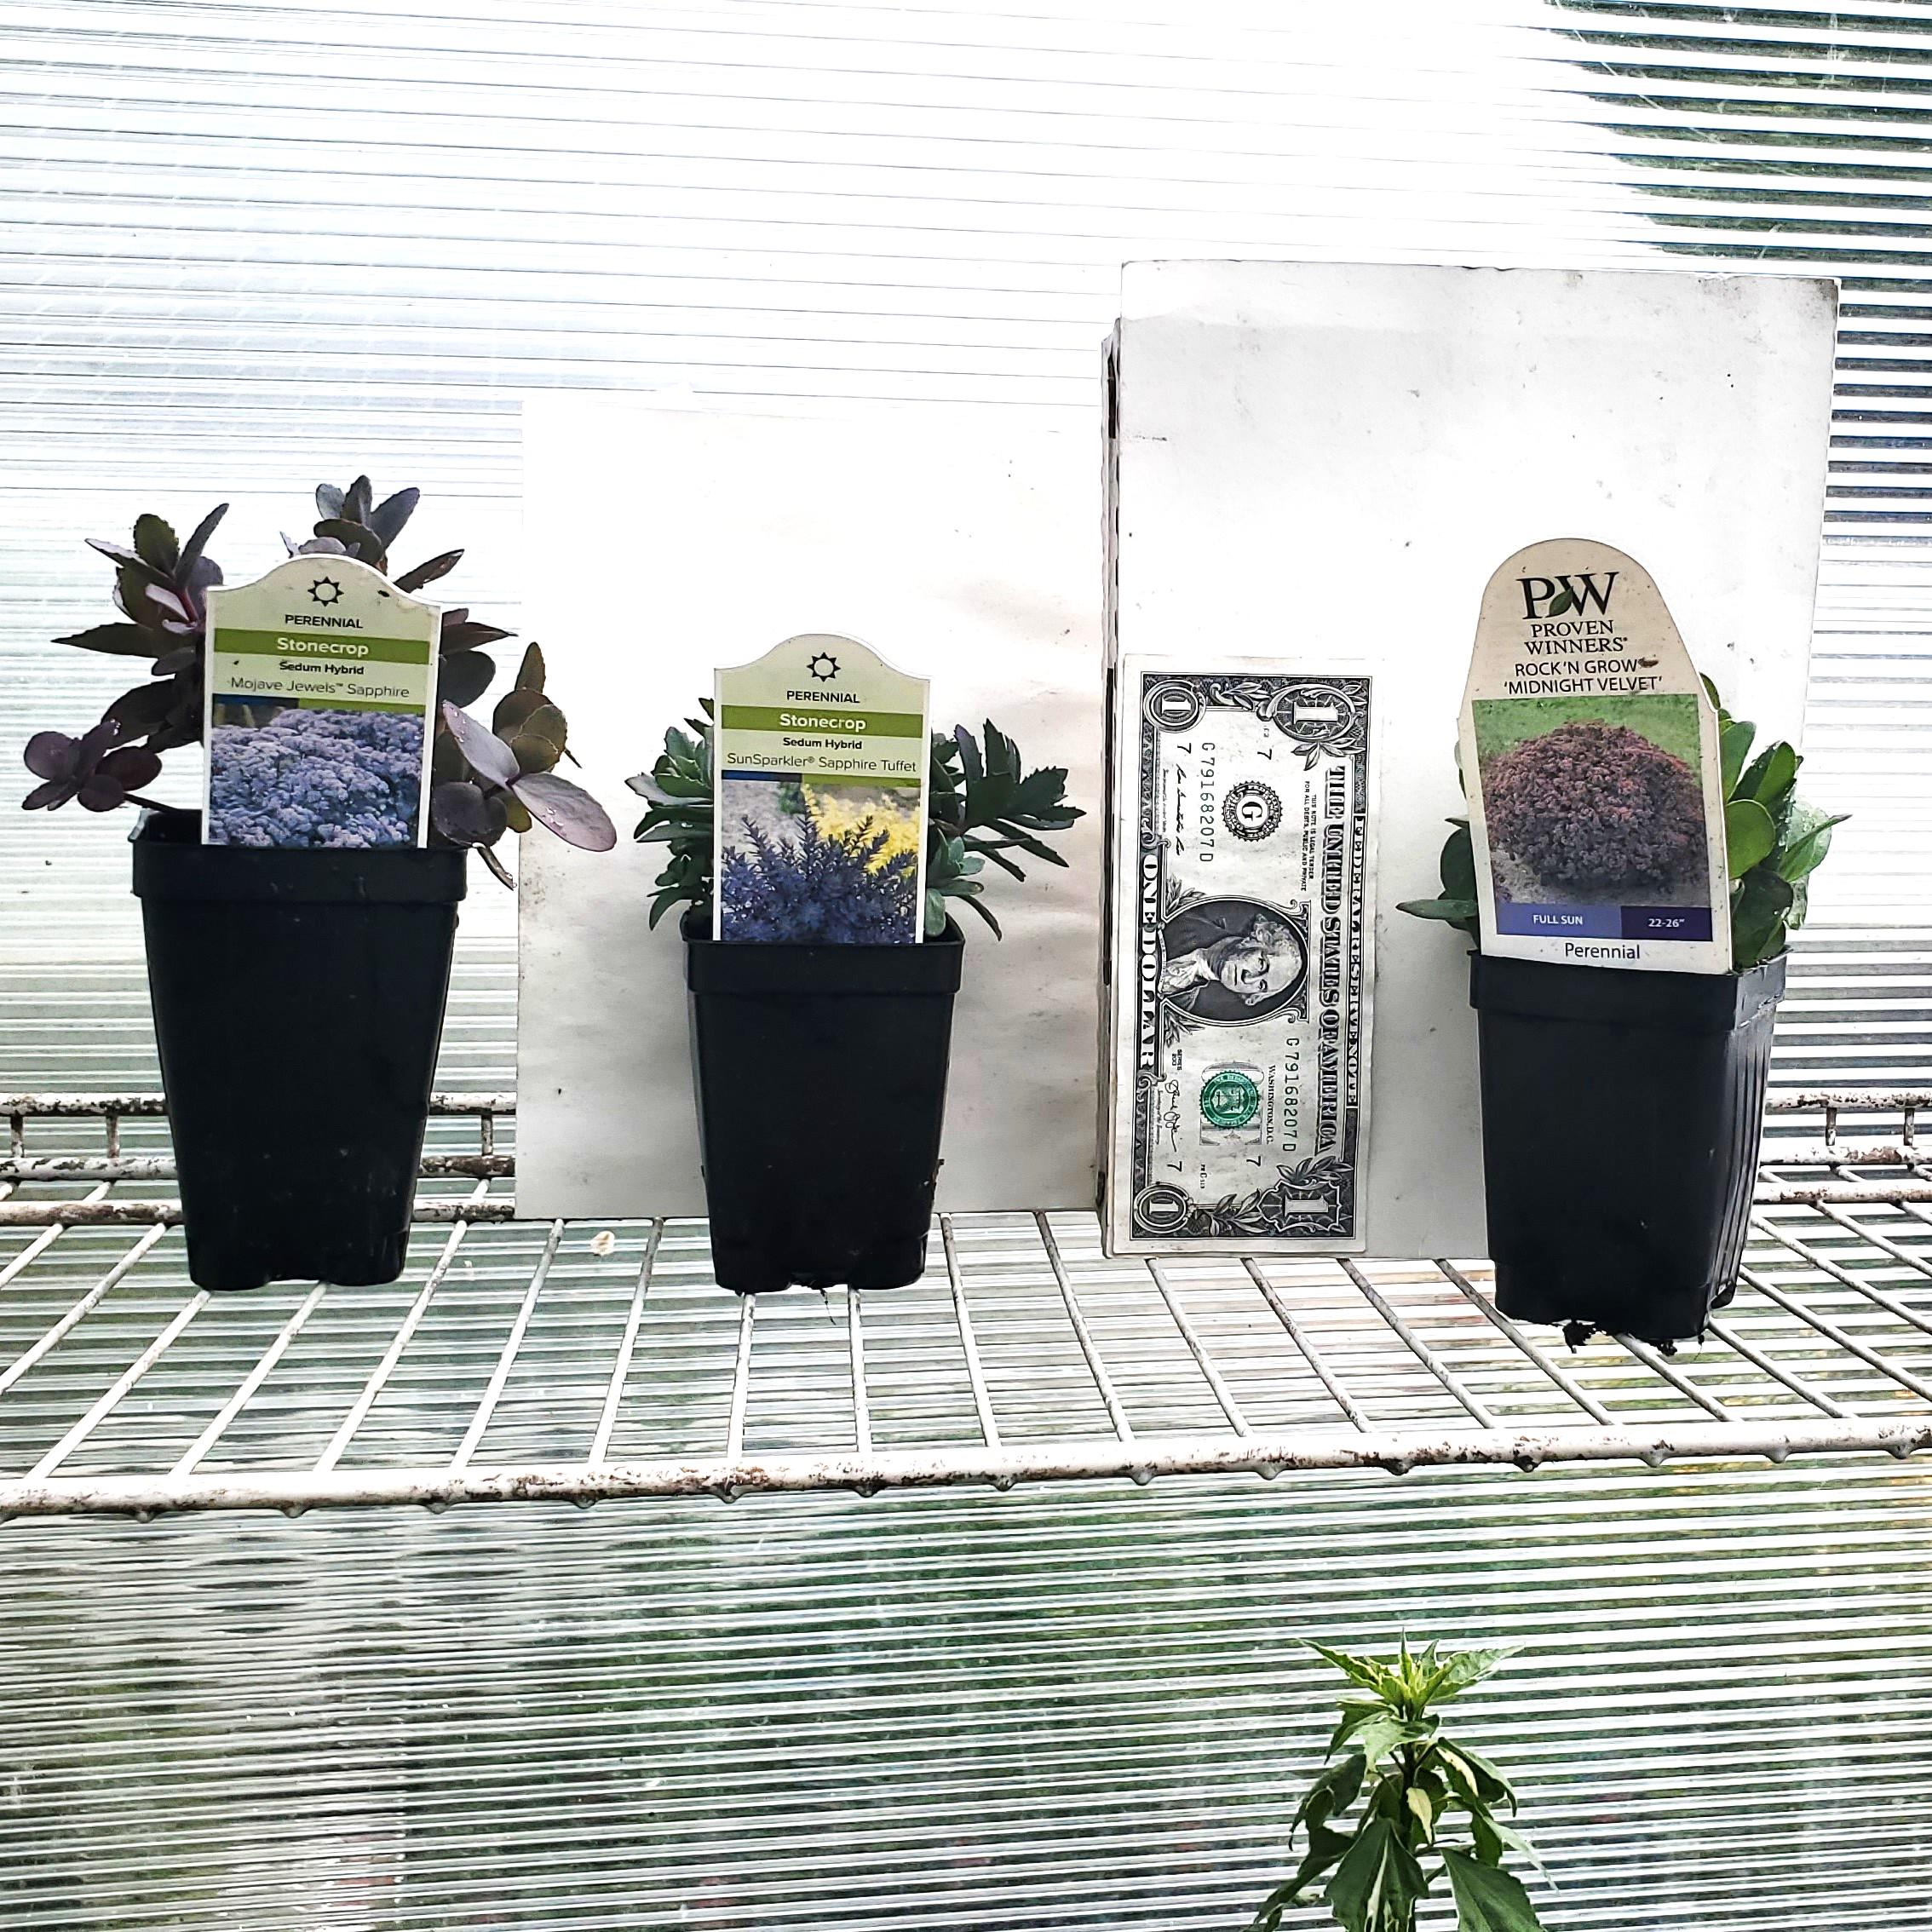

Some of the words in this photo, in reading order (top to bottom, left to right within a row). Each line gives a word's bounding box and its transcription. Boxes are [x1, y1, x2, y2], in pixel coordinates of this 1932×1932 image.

[1515, 571, 1619, 620] PW
[285, 614, 364, 629] PERENNIAL
[1531, 619, 1614, 638] PROVEN
[276, 637, 369, 658] Stonecrop
[279, 661, 322, 673] Sedum
[324, 664, 365, 676] Hybrid
[1515, 660, 1579, 676] ROCK'N
[231, 676, 283, 693] Mojave
[347, 683, 410, 698] Sapphire
[1504, 678, 1594, 695] 'MIDNIGHT
[1596, 676, 1662, 691] VELVET'
[786, 690, 860, 704] PERENNIAL
[779, 713, 866, 733] Stonecrop
[783, 737, 822, 748] Sedum
[825, 739, 862, 750] Hybrid
[1177, 742, 1192, 755] 7
[819, 756, 877, 771] Sapphire
[881, 759, 917, 773] Tuffet
[1256, 748, 1273, 761] 7
[1325, 766, 1346, 819] THE
[1241, 801, 1263, 821] G
[1321, 823, 1345, 915] UNITED
[1351, 819, 1363, 930] FEDERAL
[1142, 854, 1158, 924] ONE
[1532, 914, 1558, 924] FULL
[1561, 915, 1584, 925] SUN
[1564, 942, 1641, 959] Perennial
[1318, 917, 1342, 1008] STATES
[1348, 935, 1361, 1039] RESERVE
[1141, 929, 1157, 1071] DOLLAR
[1318, 1009, 1339, 1044] OF
[1348, 1040, 1358, 1104] NOTE
[1314, 1042, 1339, 1156] AMERICA
[1166, 1160, 1182, 1172] 7
[1245, 1155, 1261, 1167] 7
